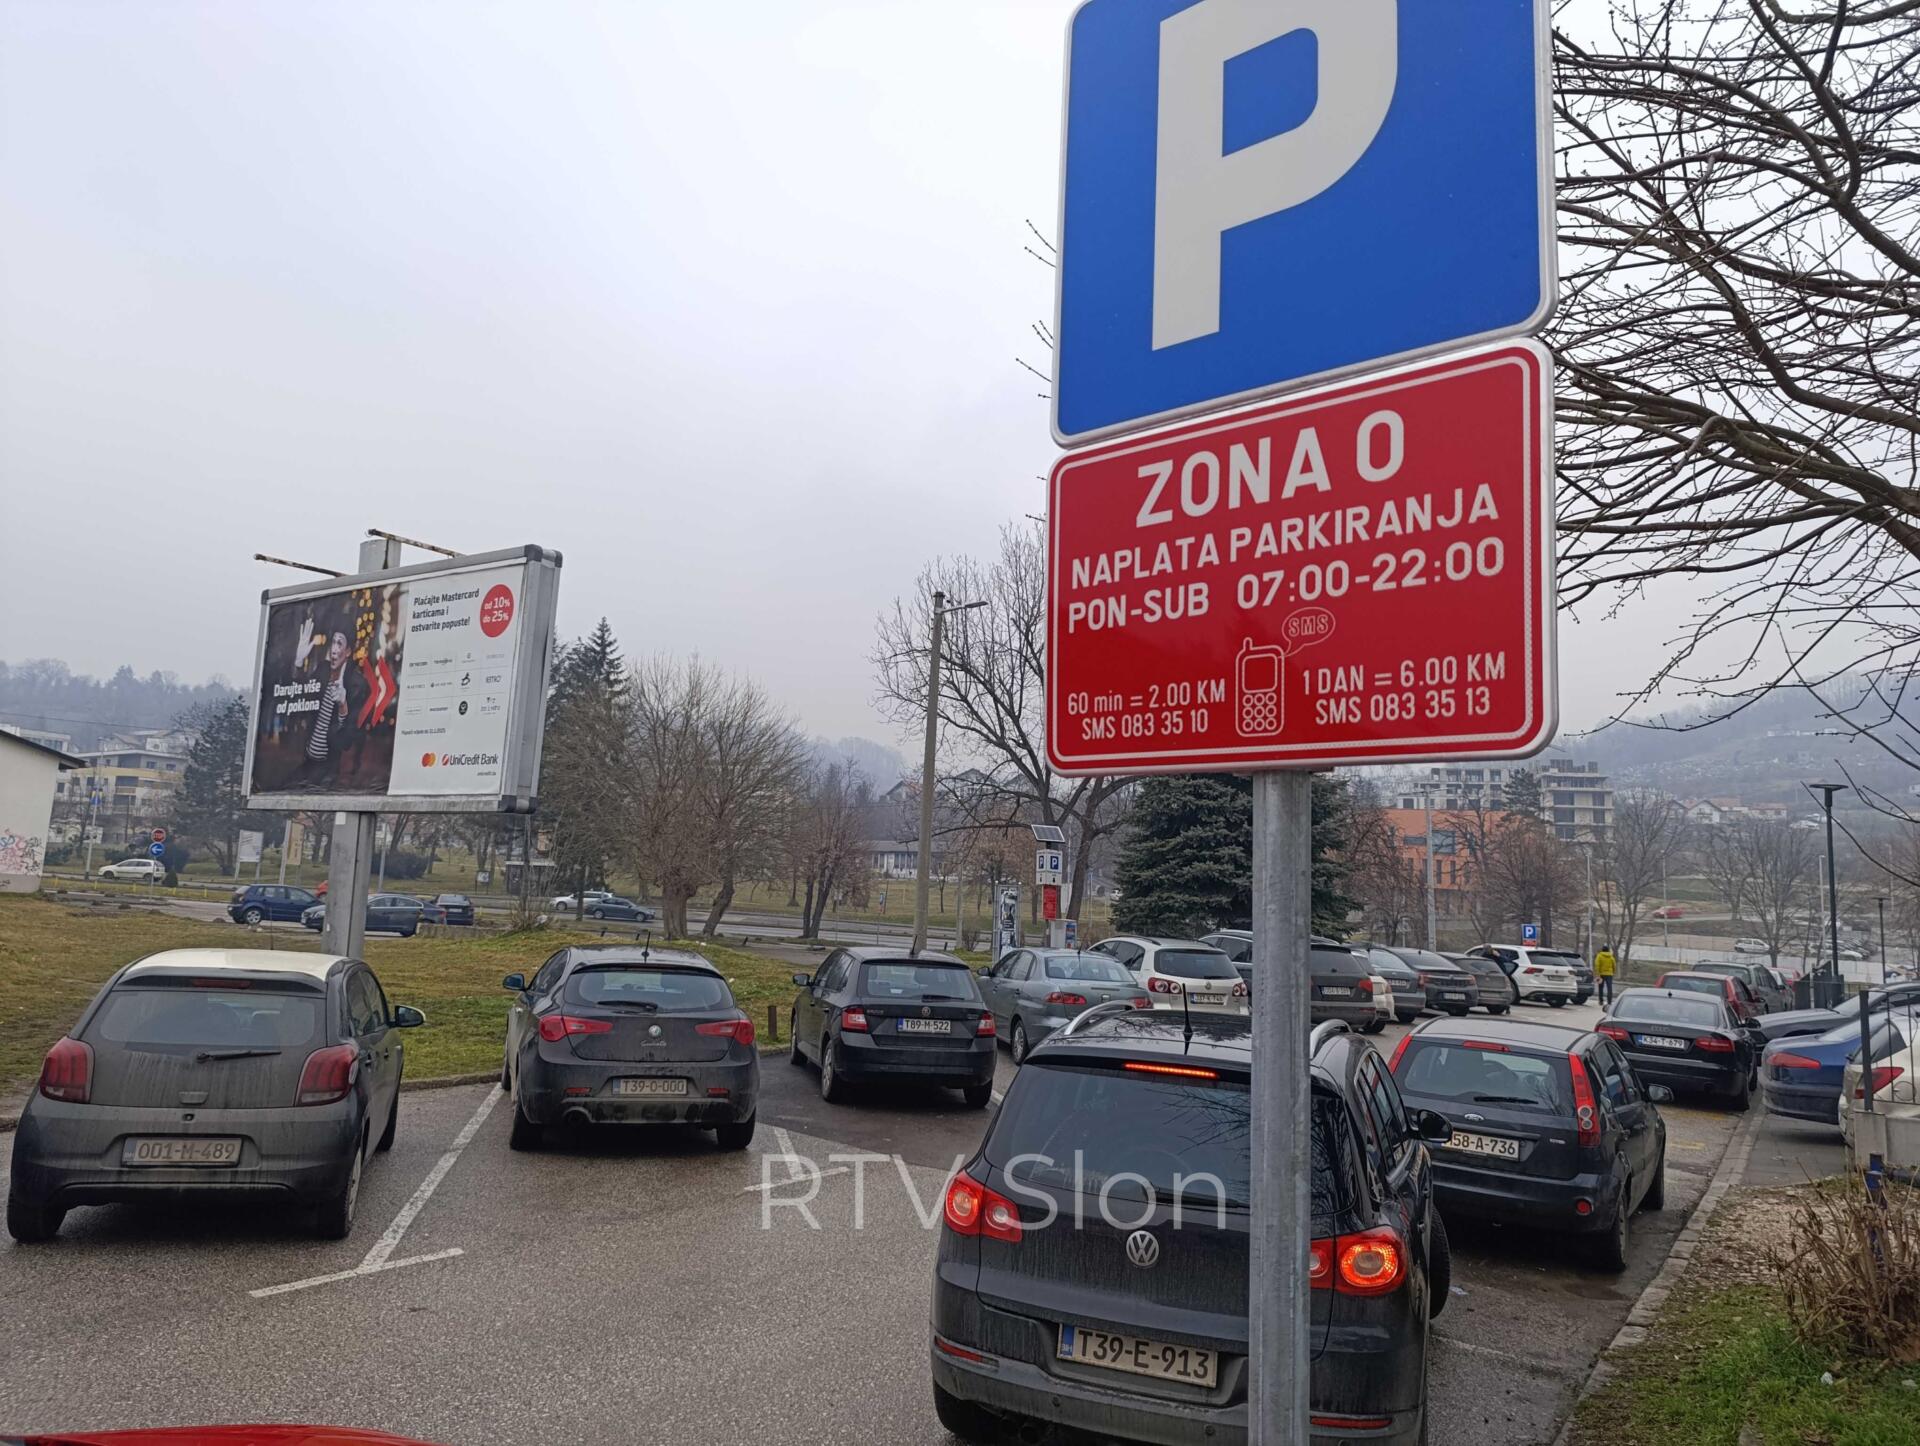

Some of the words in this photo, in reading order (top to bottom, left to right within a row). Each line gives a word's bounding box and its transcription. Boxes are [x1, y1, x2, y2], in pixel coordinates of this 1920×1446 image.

[1152, 0, 1397, 351] P
[1135, 426, 1332, 528] ZONA
[1071, 532, 1220, 590] NAPLATA
[1229, 482, 1500, 564] PARKIRANJA
[413, 594, 440, 607] Plaćajte
[441, 588, 480, 602] Mastercard
[1068, 582, 1210, 633] PON-SUB
[1236, 536, 1505, 610] 07:00-22:00
[412, 607, 445, 620] karticama
[484, 601, 493, 610] od
[493, 596, 511, 609] 10%
[491, 610, 509, 623] 25%
[411, 621, 441, 632] ostvarite
[441, 617, 471, 632] popuste!
[1288, 614, 1329, 638] SMS
[1303, 669, 1310, 696] 1
[1317, 664, 1365, 695] DAN
[1400, 655, 1458, 688] 6.00
[1466, 651, 1505, 682] KM
[274, 681, 303, 698] Darujte
[304, 679, 321, 693] više
[1067, 691, 1089, 716] 60
[1094, 689, 1123, 713] min
[1149, 681, 1191, 709] 2.00
[1197, 678, 1226, 705] KM
[276, 700, 288, 714] od
[287, 698, 320, 716] poklona
[1315, 696, 1362, 725] SMS
[1370, 692, 1416, 722] 083
[1424, 689, 1456, 718] 35
[1465, 686, 1490, 716] 13
[1081, 716, 1116, 741] SMS
[1121, 712, 1155, 738] 083
[1160, 710, 1183, 736] 35
[1190, 708, 1209, 734] 10
[449, 754, 480, 766] UniCredit
[481, 753, 499, 765] Bank
[1078, 1329, 1211, 1380] T39-E-913
